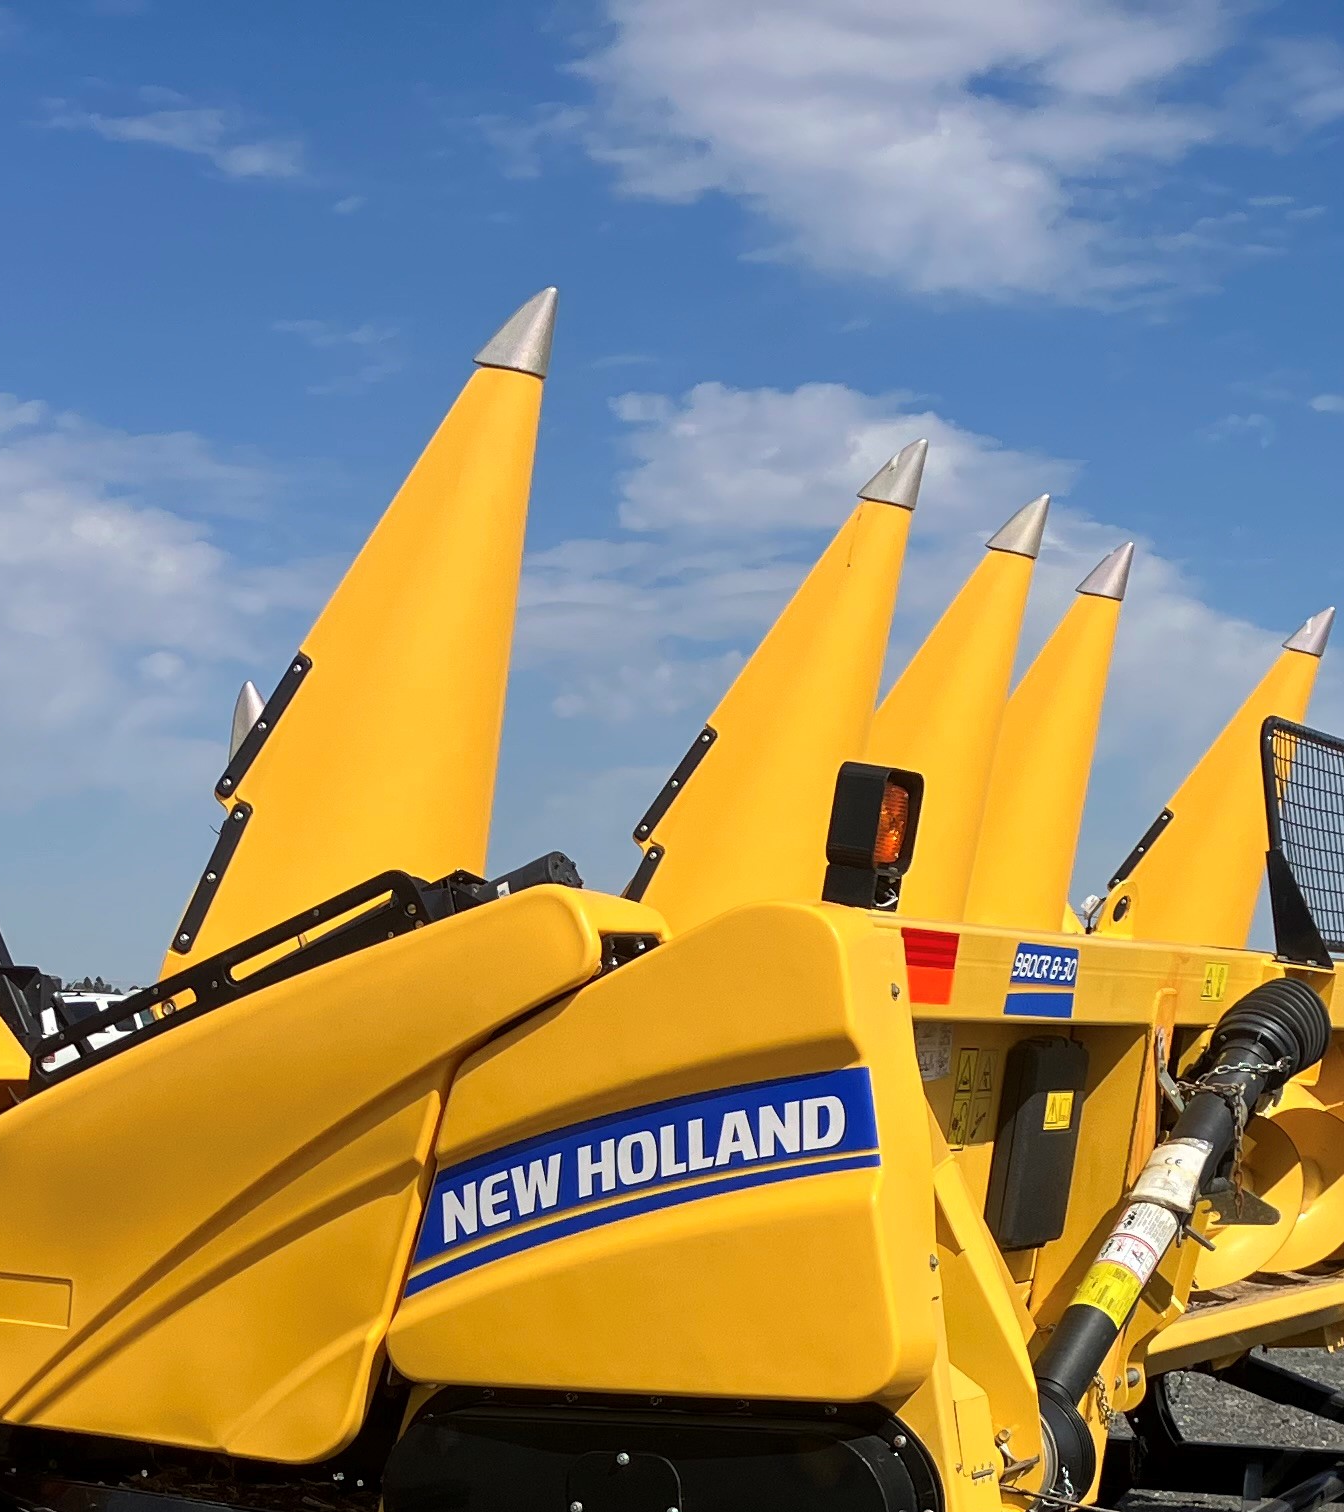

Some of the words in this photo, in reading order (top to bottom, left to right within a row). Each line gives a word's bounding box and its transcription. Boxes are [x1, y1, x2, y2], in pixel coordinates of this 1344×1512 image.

[1011, 952, 1052, 979] 980CR
[1049, 956, 1077, 981] 8-30
[442, 1152, 561, 1244] NEW
[577, 1095, 846, 1199] HOLLAND
